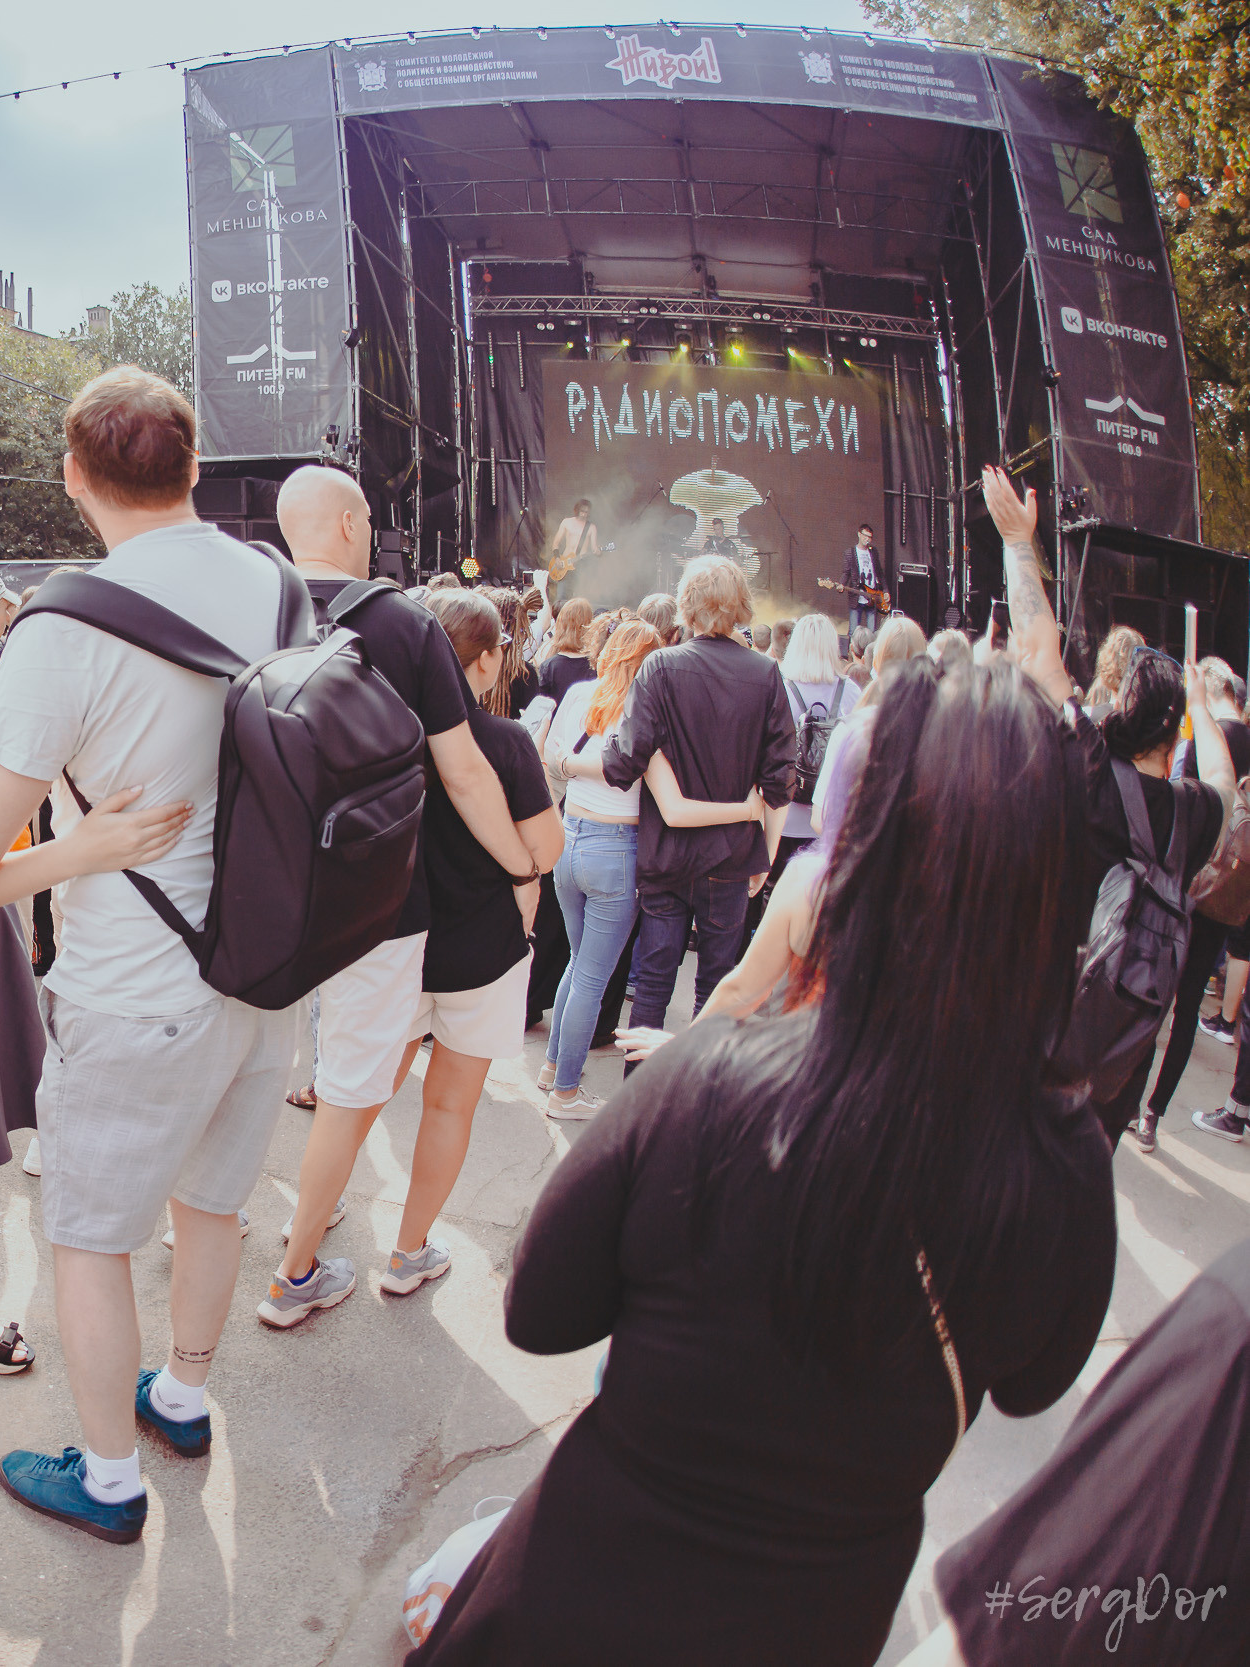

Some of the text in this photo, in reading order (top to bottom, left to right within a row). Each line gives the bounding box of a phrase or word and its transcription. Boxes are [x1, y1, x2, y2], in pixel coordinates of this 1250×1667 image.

[395, 56, 428, 67] КОМИТЕТ
[396, 60, 514, 77] ПОЛИТИКЕ И ВЗАИМОДЕЙСТВИЮ
[839, 55, 872, 66] КОМИТЕТ
[873, 58, 884, 68] ПО
[397, 71, 538, 88] С ОБЩЕСТВЕННЫМИ ОРГАНИЗАЦИЯМИ
[841, 65, 955, 88] ПОЛИТИКЕ И ВЗАИМОДЕЙСТВИЮ
[845, 78, 978, 104] С ОБЩЕСТВЕННЫМИ ОРГАНИЗАЦИЯМИ
[1081, 226, 1117, 246] САД
[1045, 235, 1157, 273] МЕНШИКОВА
[286, 367, 306, 379] FM
[257, 384, 285, 395] 100.9
[565, 382, 859, 455] РАДИОПОМЕХИ
[1141, 428, 1159, 445] FM
[1117, 442, 1142, 457] 100.9
